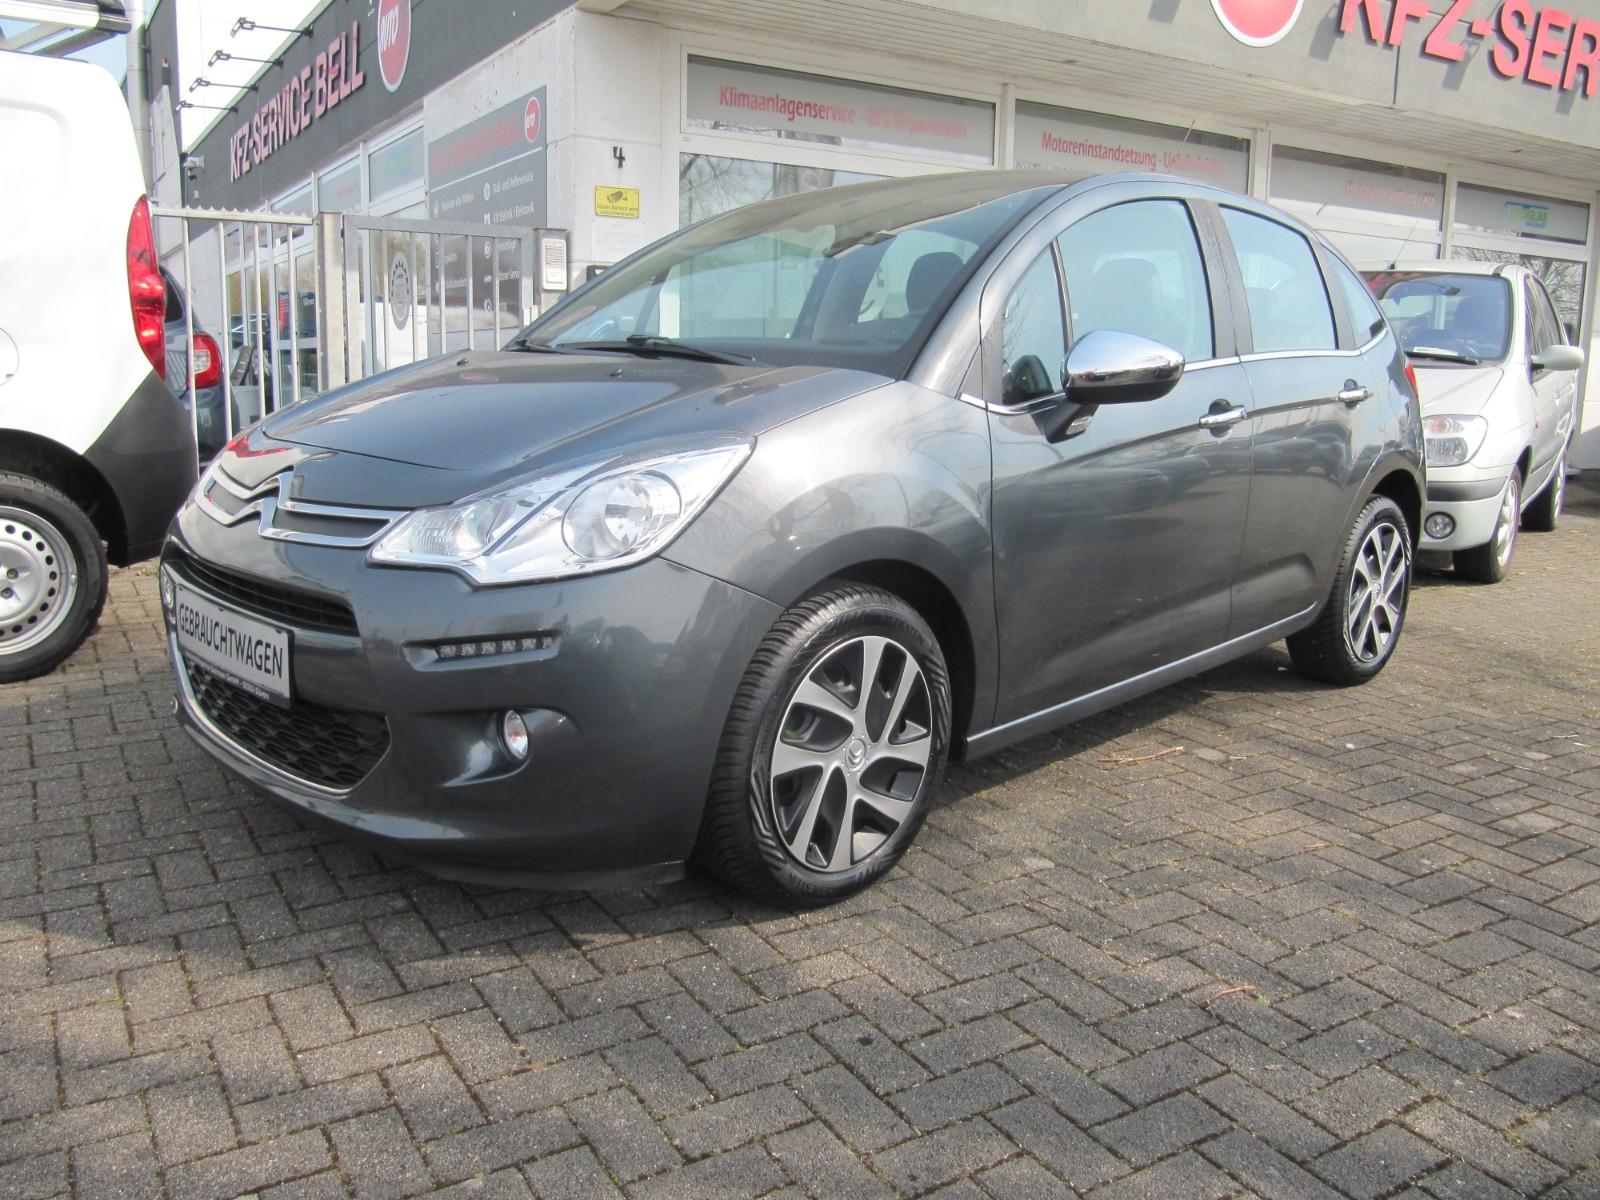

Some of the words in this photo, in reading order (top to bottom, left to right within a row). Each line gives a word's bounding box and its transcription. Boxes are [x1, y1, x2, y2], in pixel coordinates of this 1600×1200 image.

[230, 65, 312, 183] KFZ-SERVICE
[315, 20, 364, 119] BELL
[719, 85, 856, 123] Klimaanlagenservice
[613, 146, 626, 169] 4
[1041, 132, 1157, 171] Motoreninstandsetzung
[179, 602, 284, 680] GEBRAUCHTWAGEN
